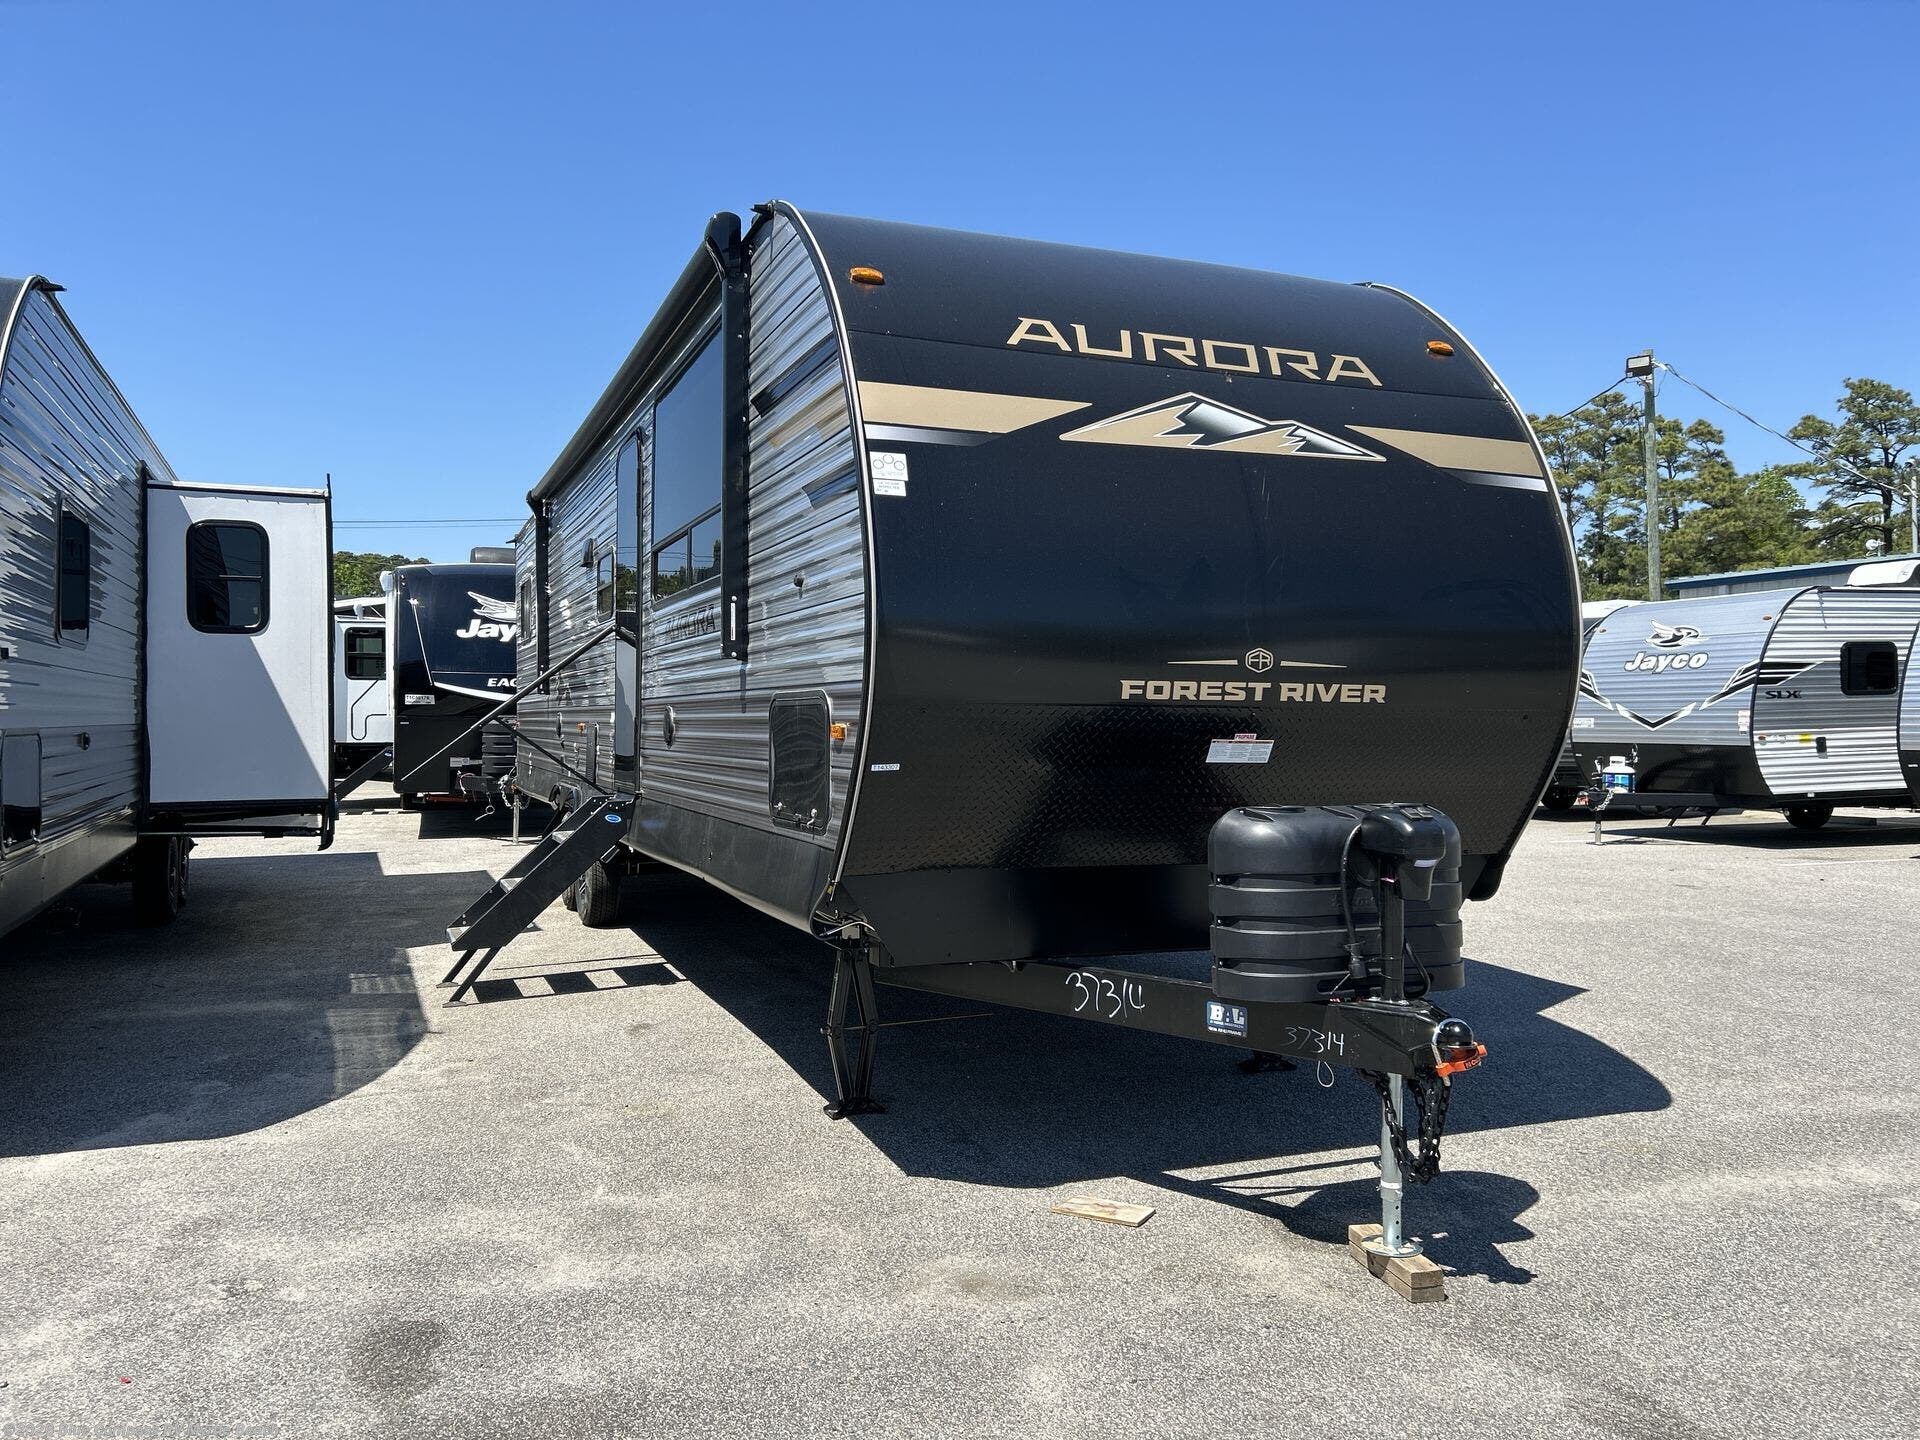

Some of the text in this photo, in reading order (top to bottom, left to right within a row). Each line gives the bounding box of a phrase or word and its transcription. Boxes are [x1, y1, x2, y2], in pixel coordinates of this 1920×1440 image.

[1006, 317, 1383, 387] AURORA
[456, 619, 517, 642] Jay
[1623, 650, 1709, 675] Jayco
[487, 677, 518, 688] EAG
[1119, 679, 1387, 704] FOREST RIVER
[1764, 689, 1799, 700] SLX
[1065, 971, 1146, 1018] 37314
[1279, 1025, 1345, 1057] 37314
